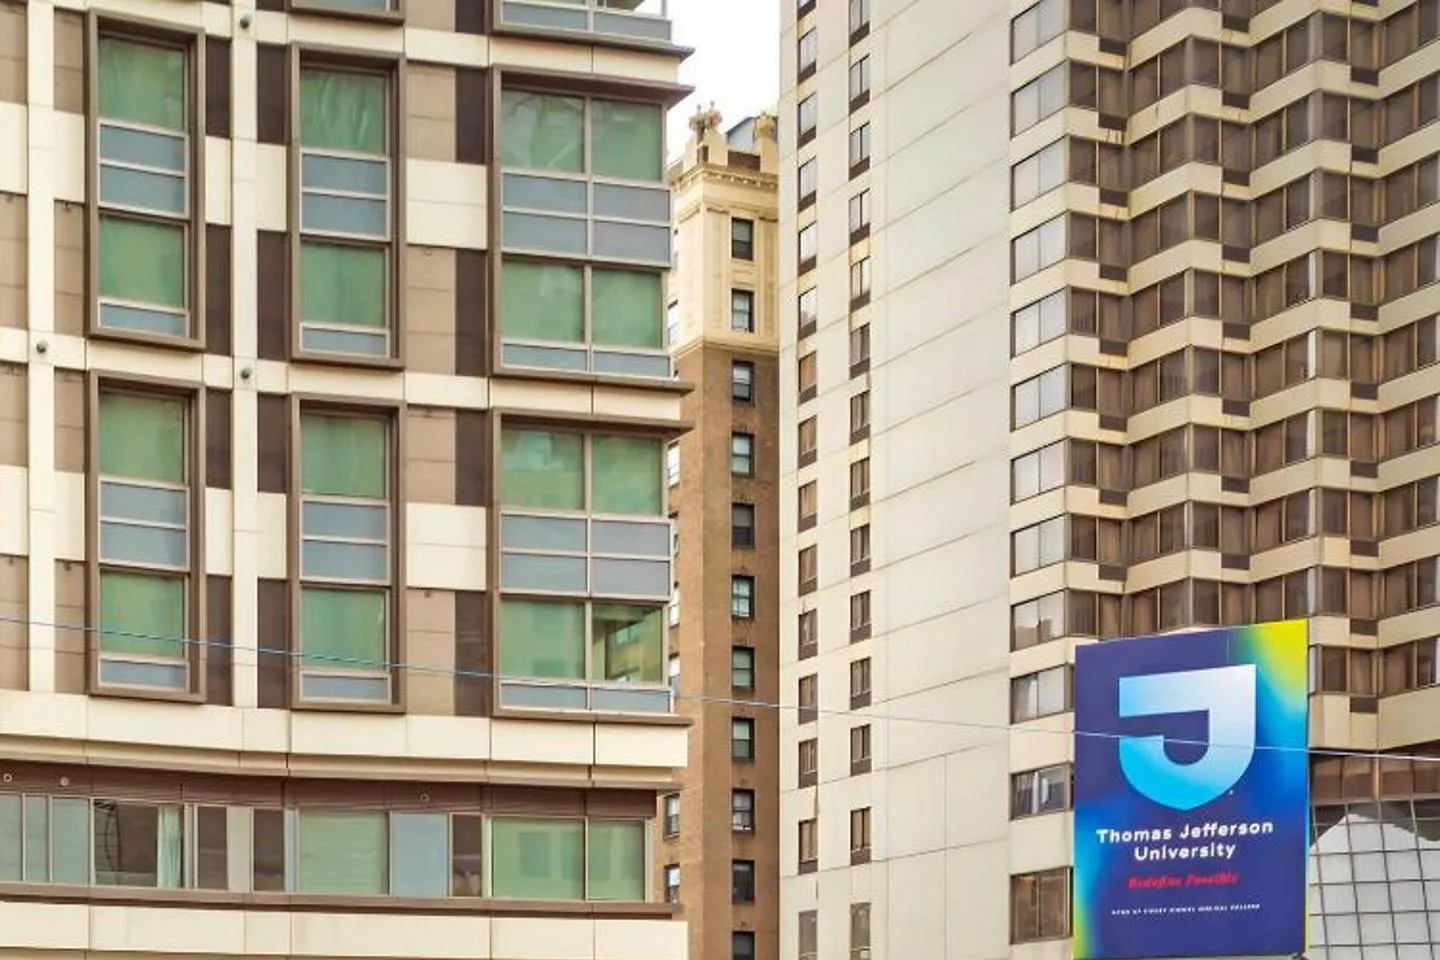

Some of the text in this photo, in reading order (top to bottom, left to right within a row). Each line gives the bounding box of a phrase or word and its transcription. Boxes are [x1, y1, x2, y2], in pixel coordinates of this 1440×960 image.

[1095, 820, 1274, 844] Thomas Jefferson
[1133, 842, 1236, 862] University
